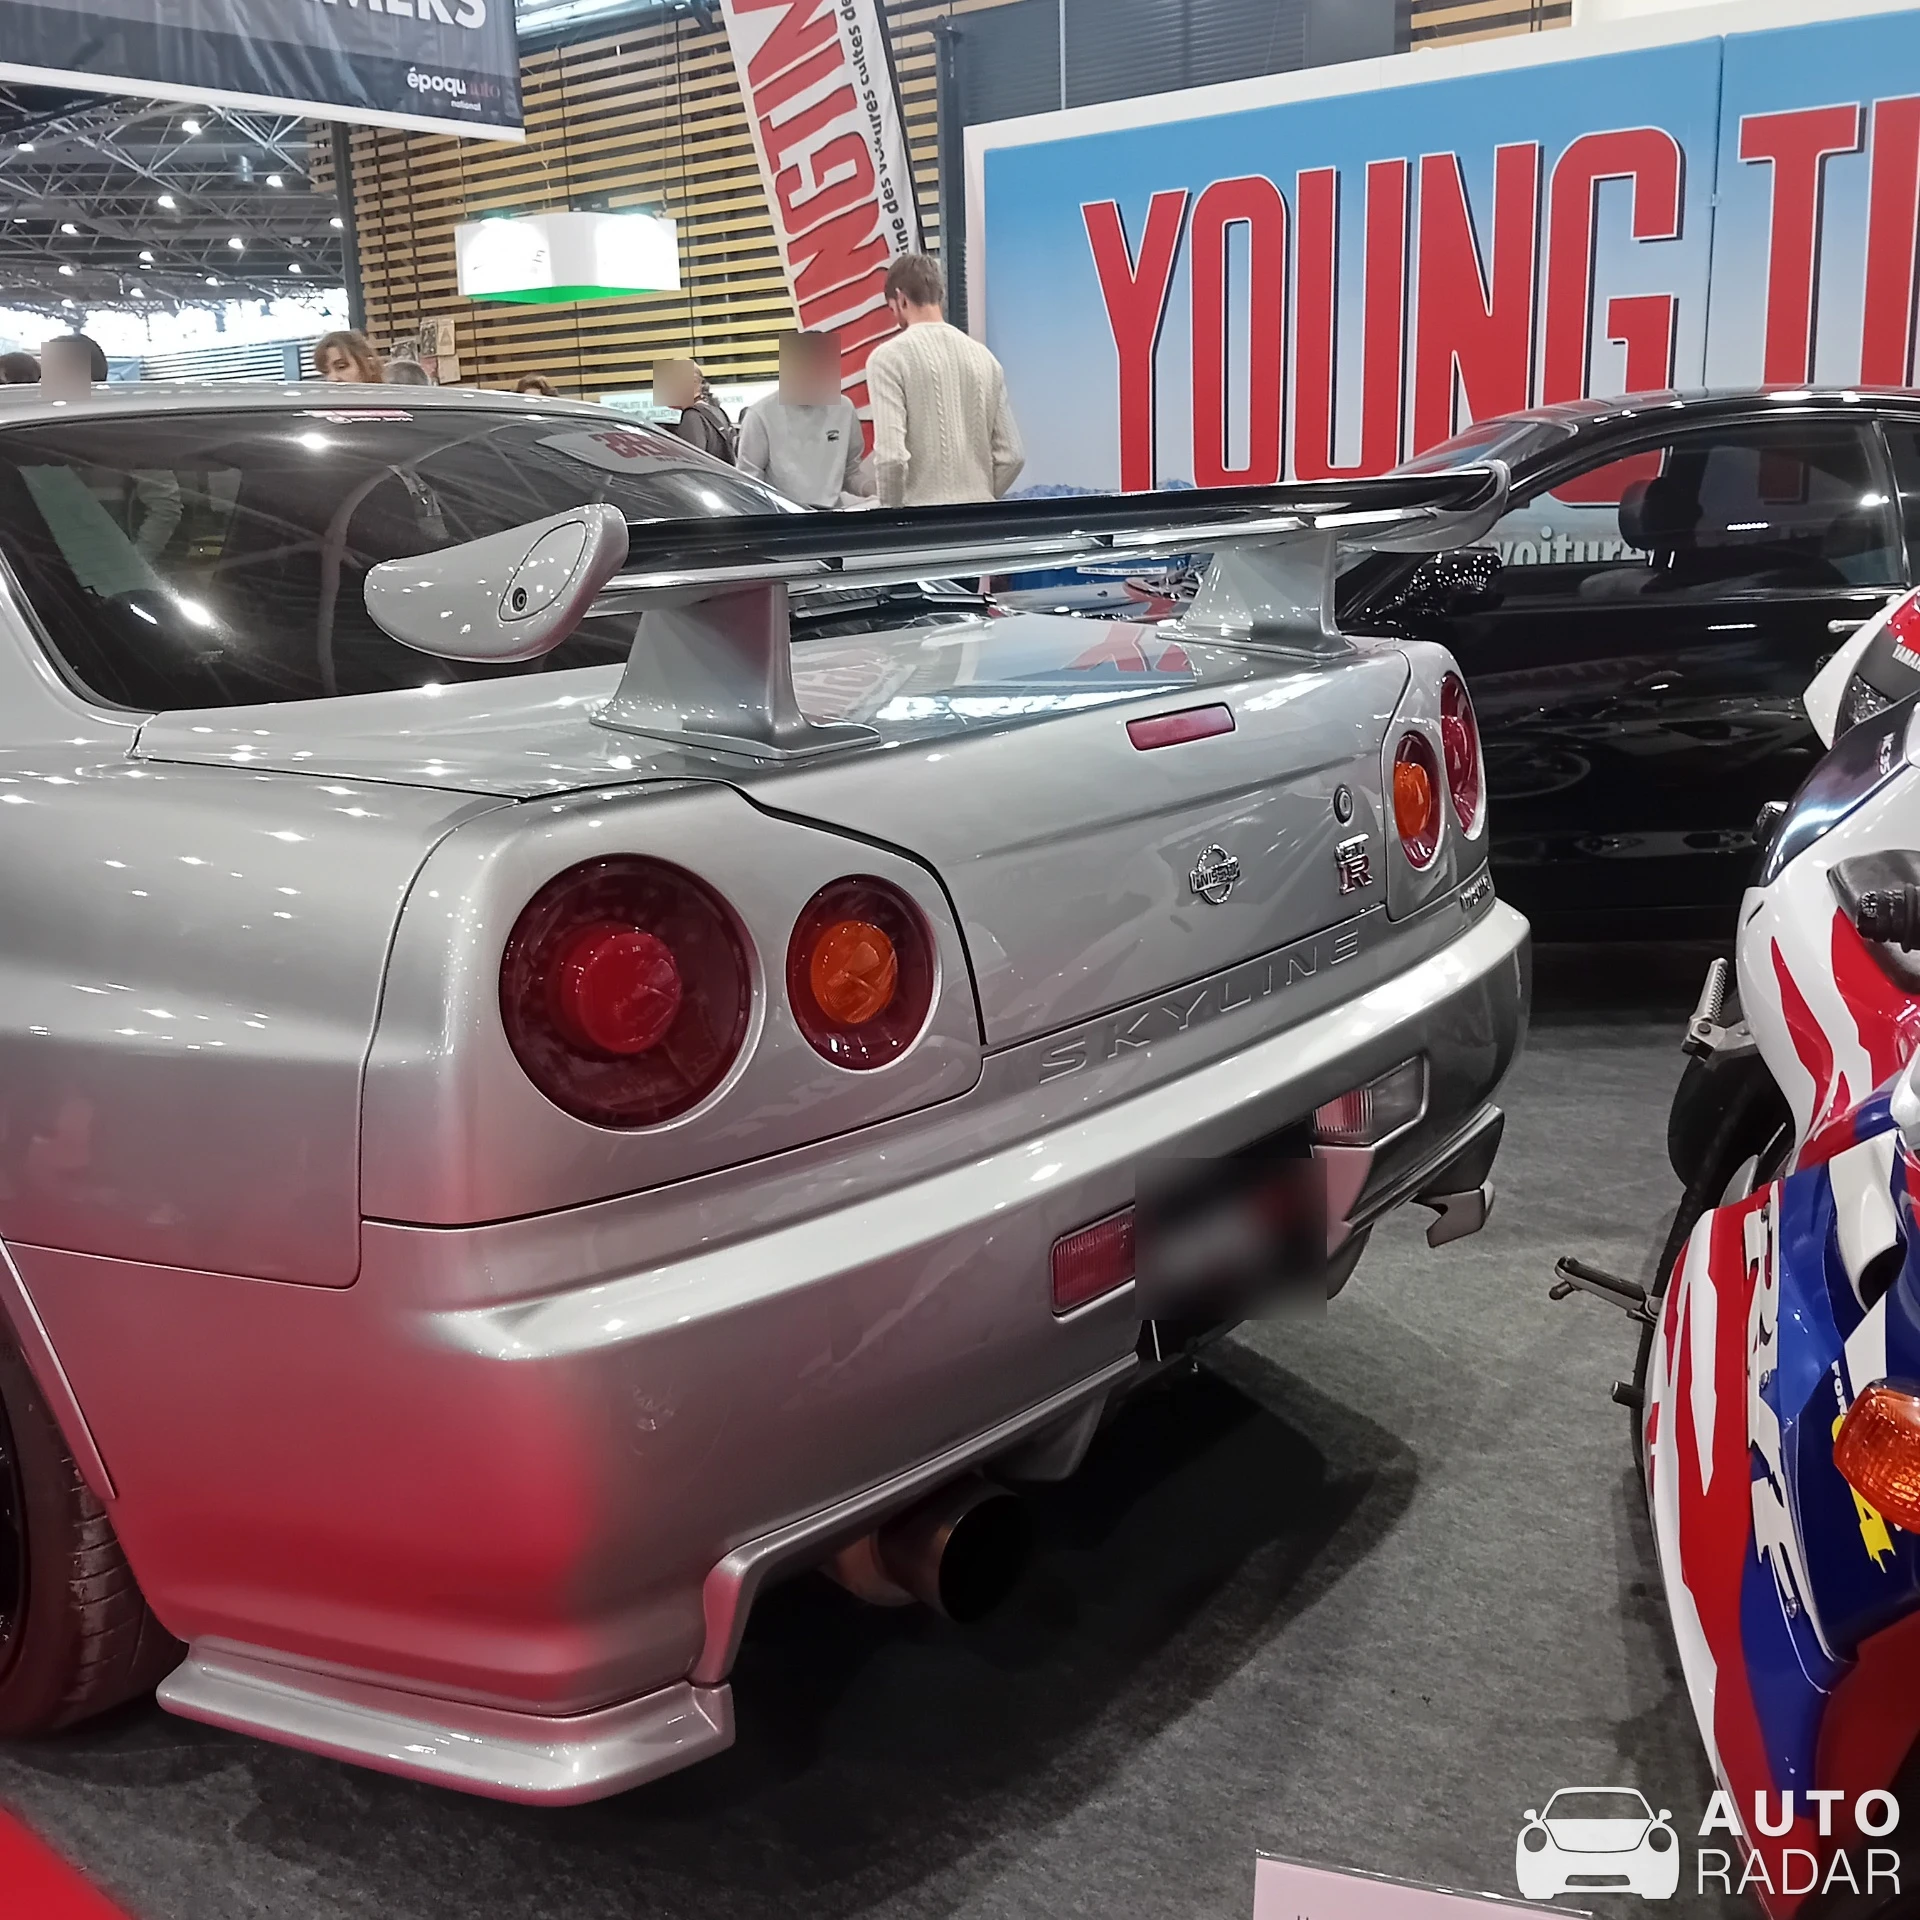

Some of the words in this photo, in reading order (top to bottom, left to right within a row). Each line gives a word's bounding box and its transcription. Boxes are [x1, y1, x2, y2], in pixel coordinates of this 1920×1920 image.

[847, 24, 870, 87] cultes
[880, 177, 899, 215] des
[1080, 125, 1687, 507] YOUNG
[1039, 929, 1359, 1084] SKYLINE
